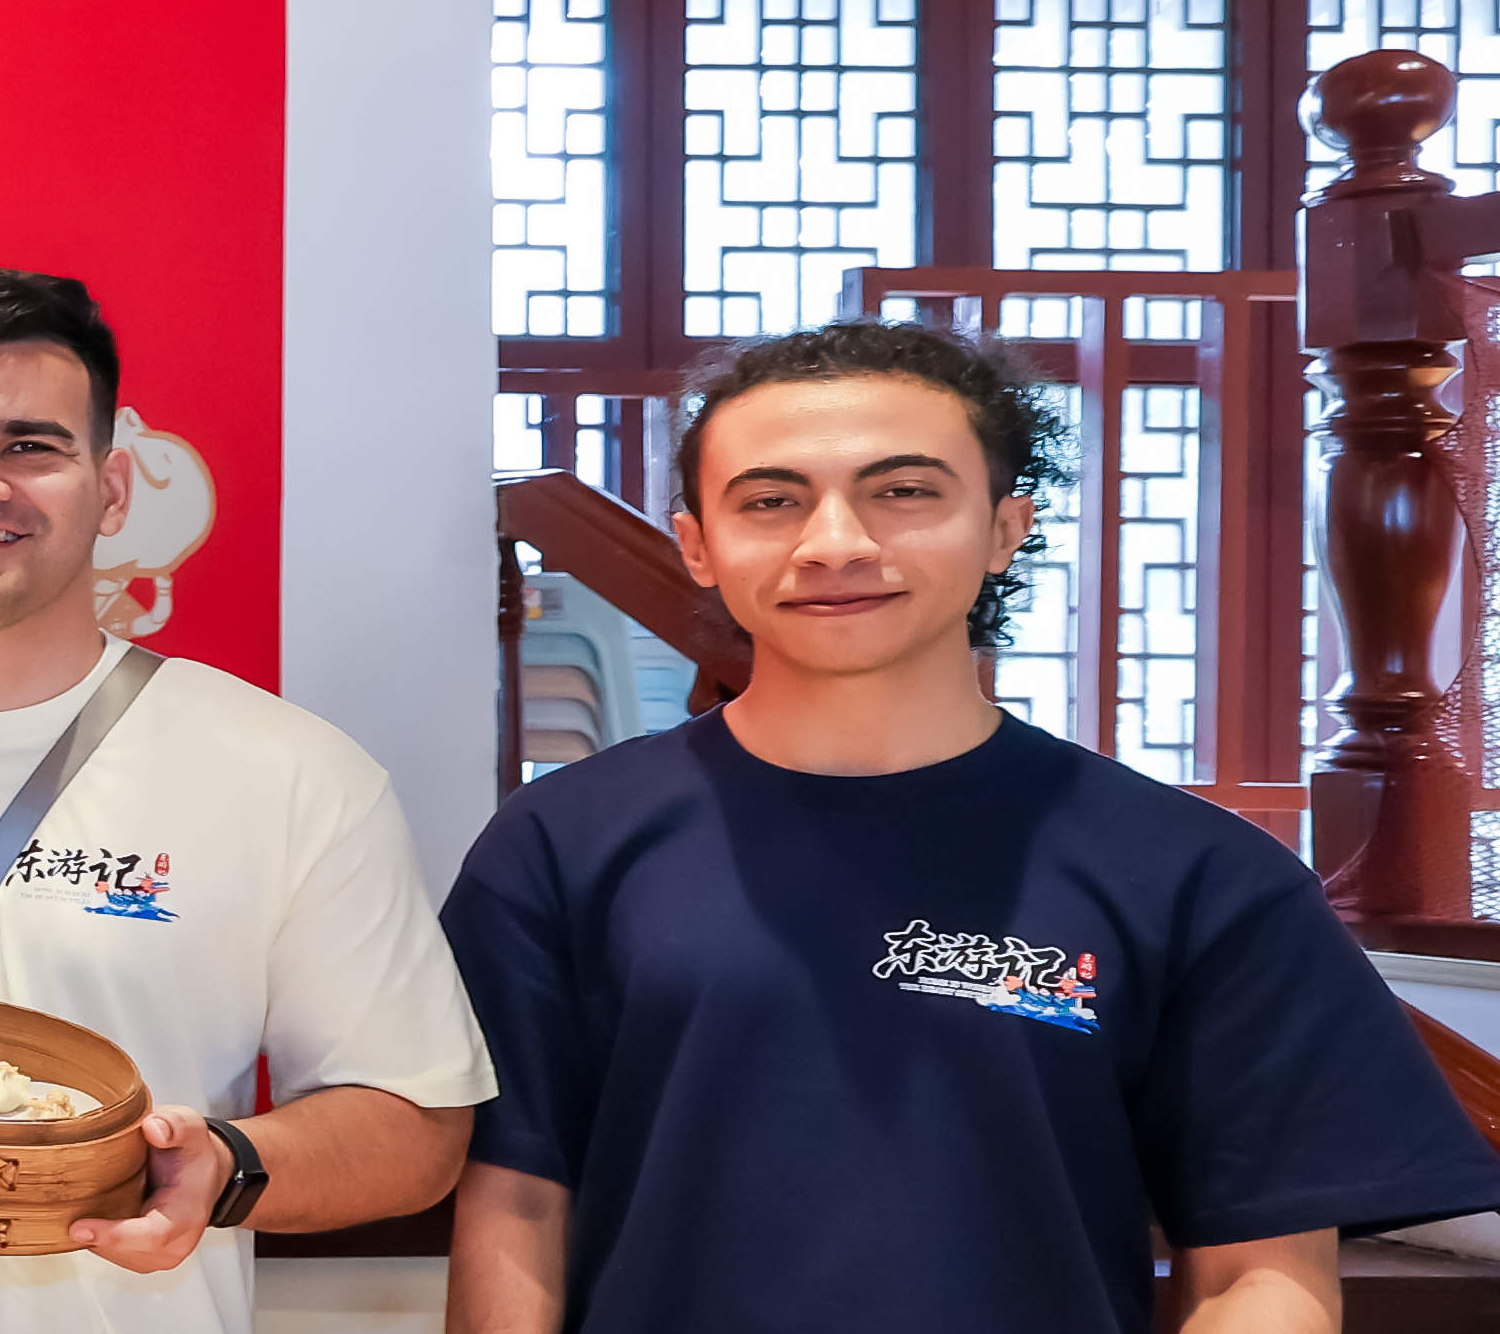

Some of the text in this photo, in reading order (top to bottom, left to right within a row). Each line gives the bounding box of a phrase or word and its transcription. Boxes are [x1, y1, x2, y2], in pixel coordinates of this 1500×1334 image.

[5, 838, 142, 889] 东游记
[872, 919, 1067, 994] 东游记
